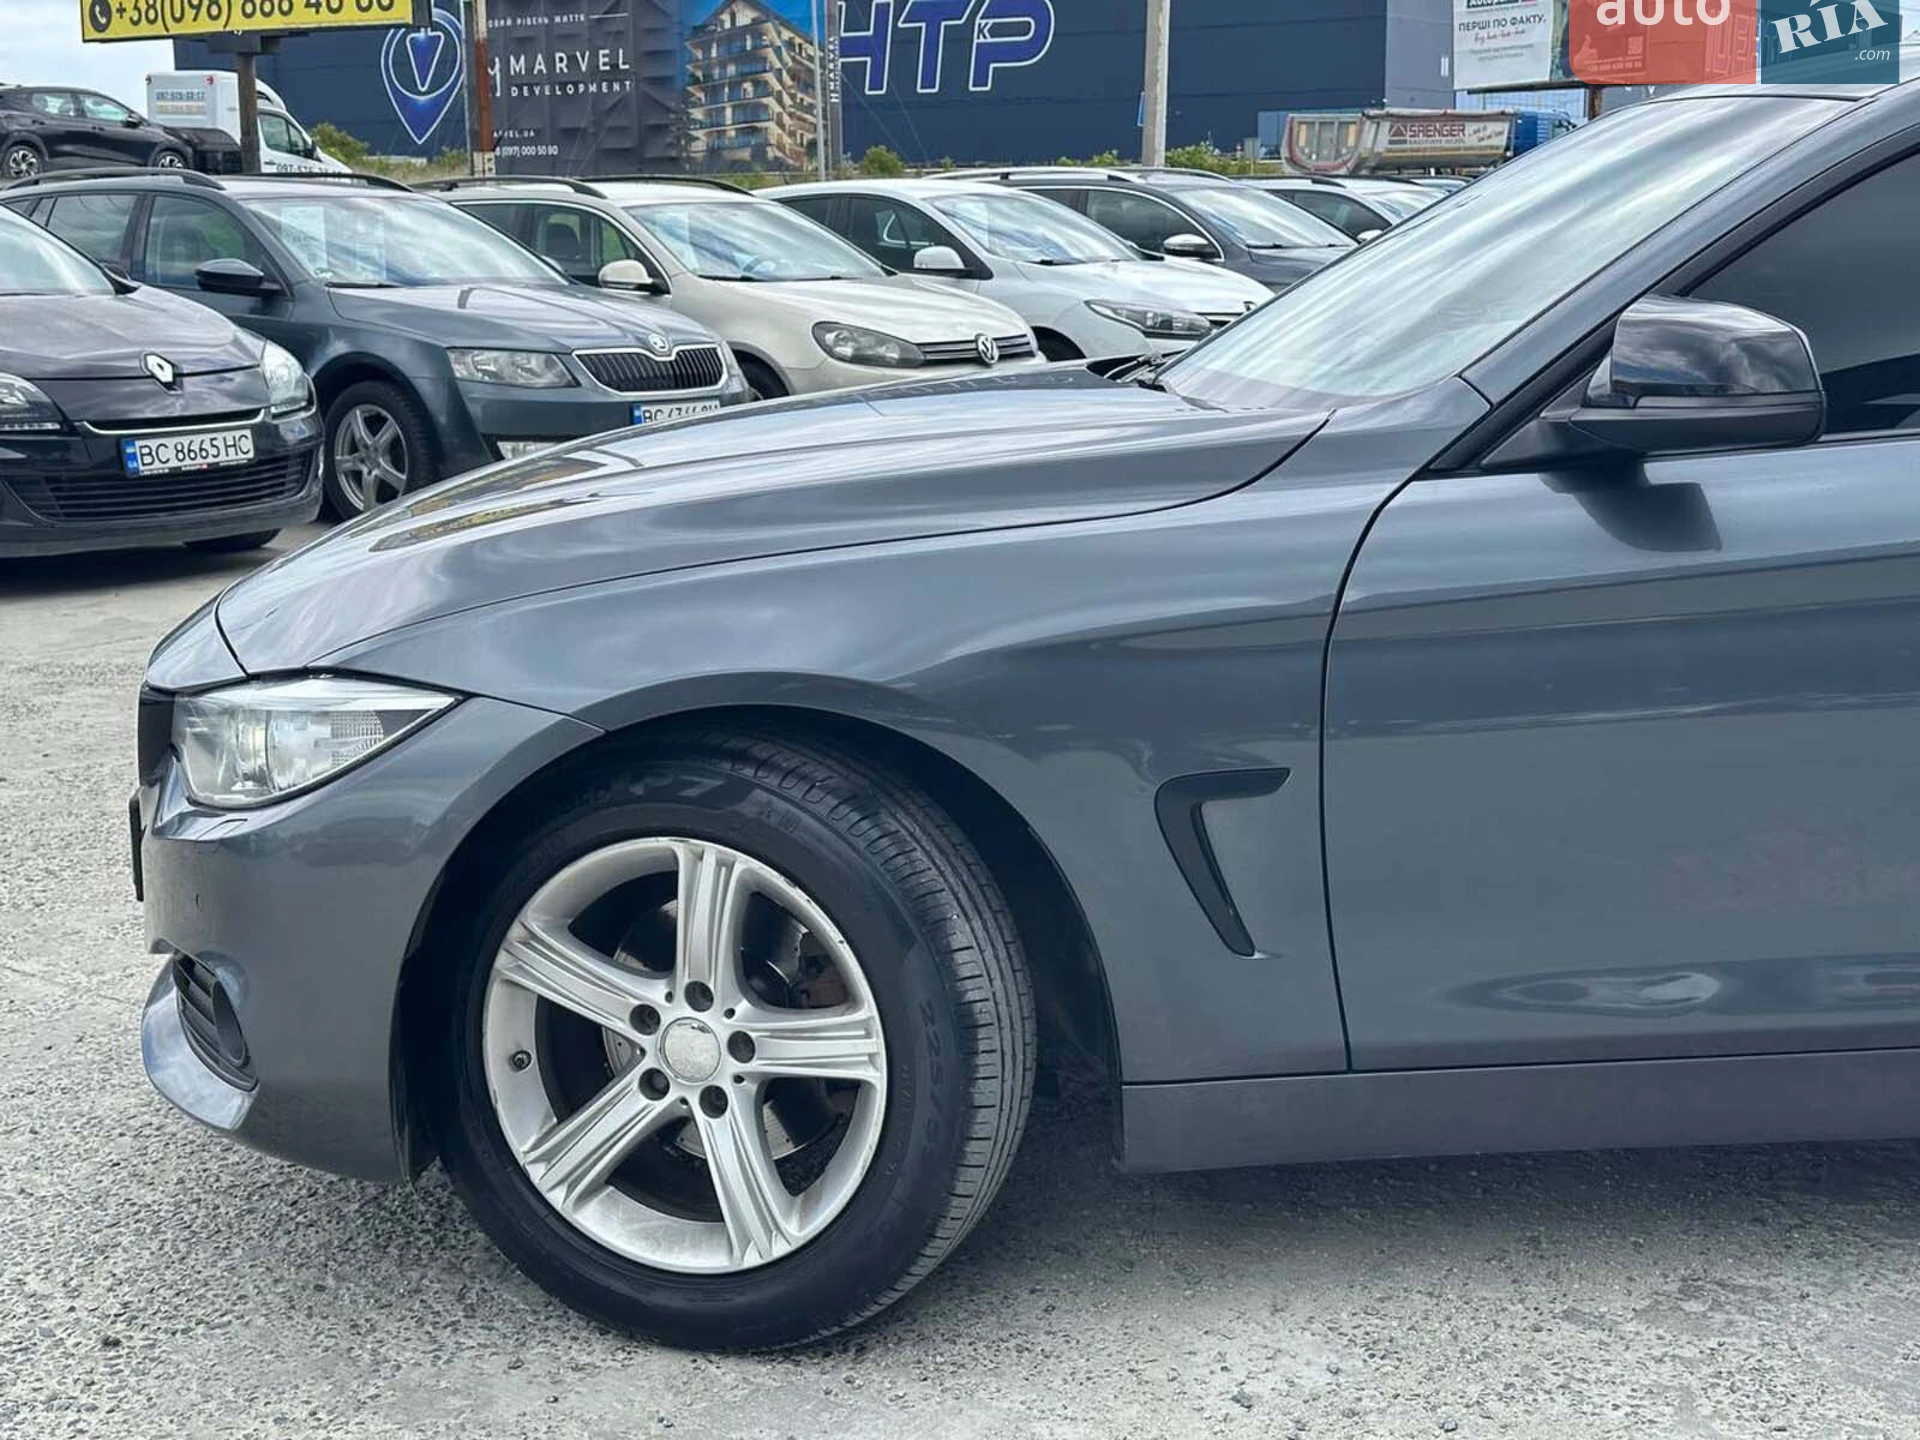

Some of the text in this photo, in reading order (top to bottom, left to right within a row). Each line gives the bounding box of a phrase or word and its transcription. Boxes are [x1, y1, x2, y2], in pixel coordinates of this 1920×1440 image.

[1459, 19, 1491, 31] ПЕРШІ
[1493, 18, 1508, 28] ПО
[509, 48, 631, 76] MARVEL
[510, 80, 633, 97] DEVELOPMENT
[138, 434, 251, 467] BC 8665 HC
